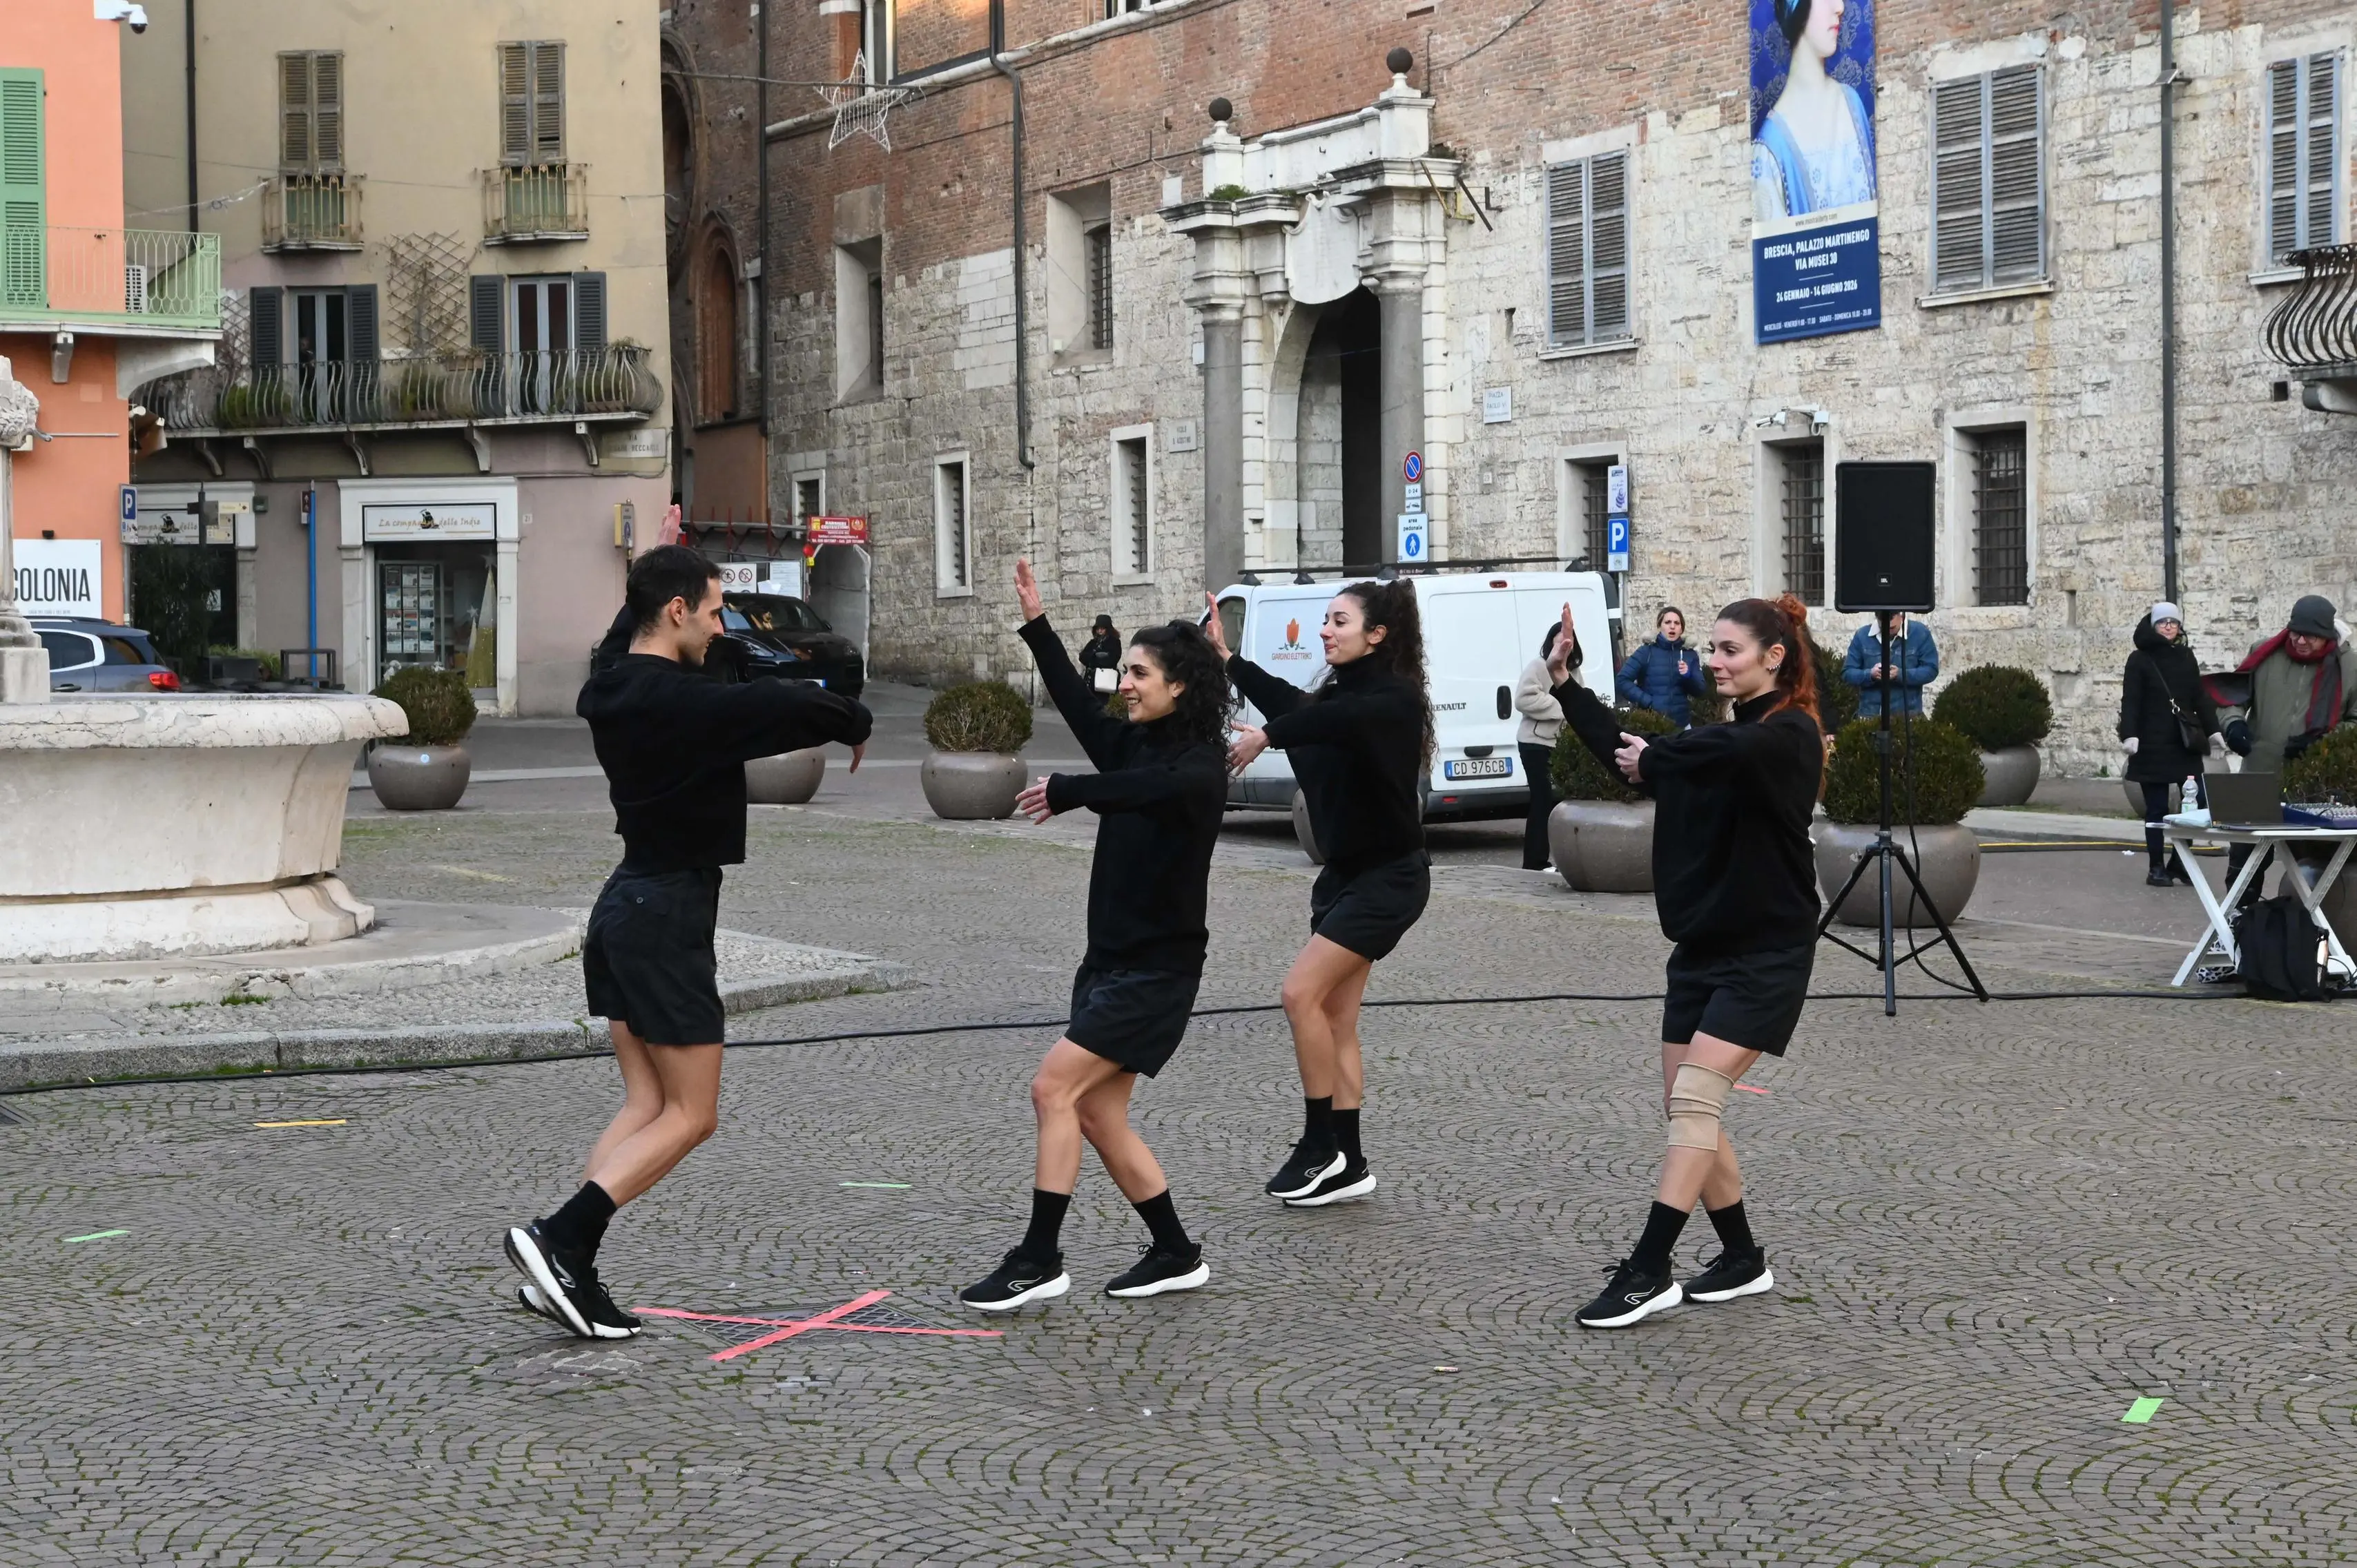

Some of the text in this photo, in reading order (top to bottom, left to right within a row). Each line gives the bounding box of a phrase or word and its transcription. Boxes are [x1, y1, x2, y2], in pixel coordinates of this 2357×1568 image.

[1764, 229, 1870, 259] BRESCIA, PALAZZO MARTINENGO
[1795, 252, 1838, 271] VIA MUSEI 30
[1776, 292, 1783, 302] 24
[1783, 287, 1810, 301] GENNAIO
[1814, 286, 1821, 296] 14
[1821, 282, 1843, 294] GIUGNO
[1843, 279, 1858, 291] 2026
[125, 493, 133, 515] P
[378, 519, 391, 527] La
[1611, 522, 1624, 551] P
[1431, 702, 1467, 712] RENAULT
[1454, 762, 1468, 775] CD
[1471, 759, 1505, 774] 976CB
